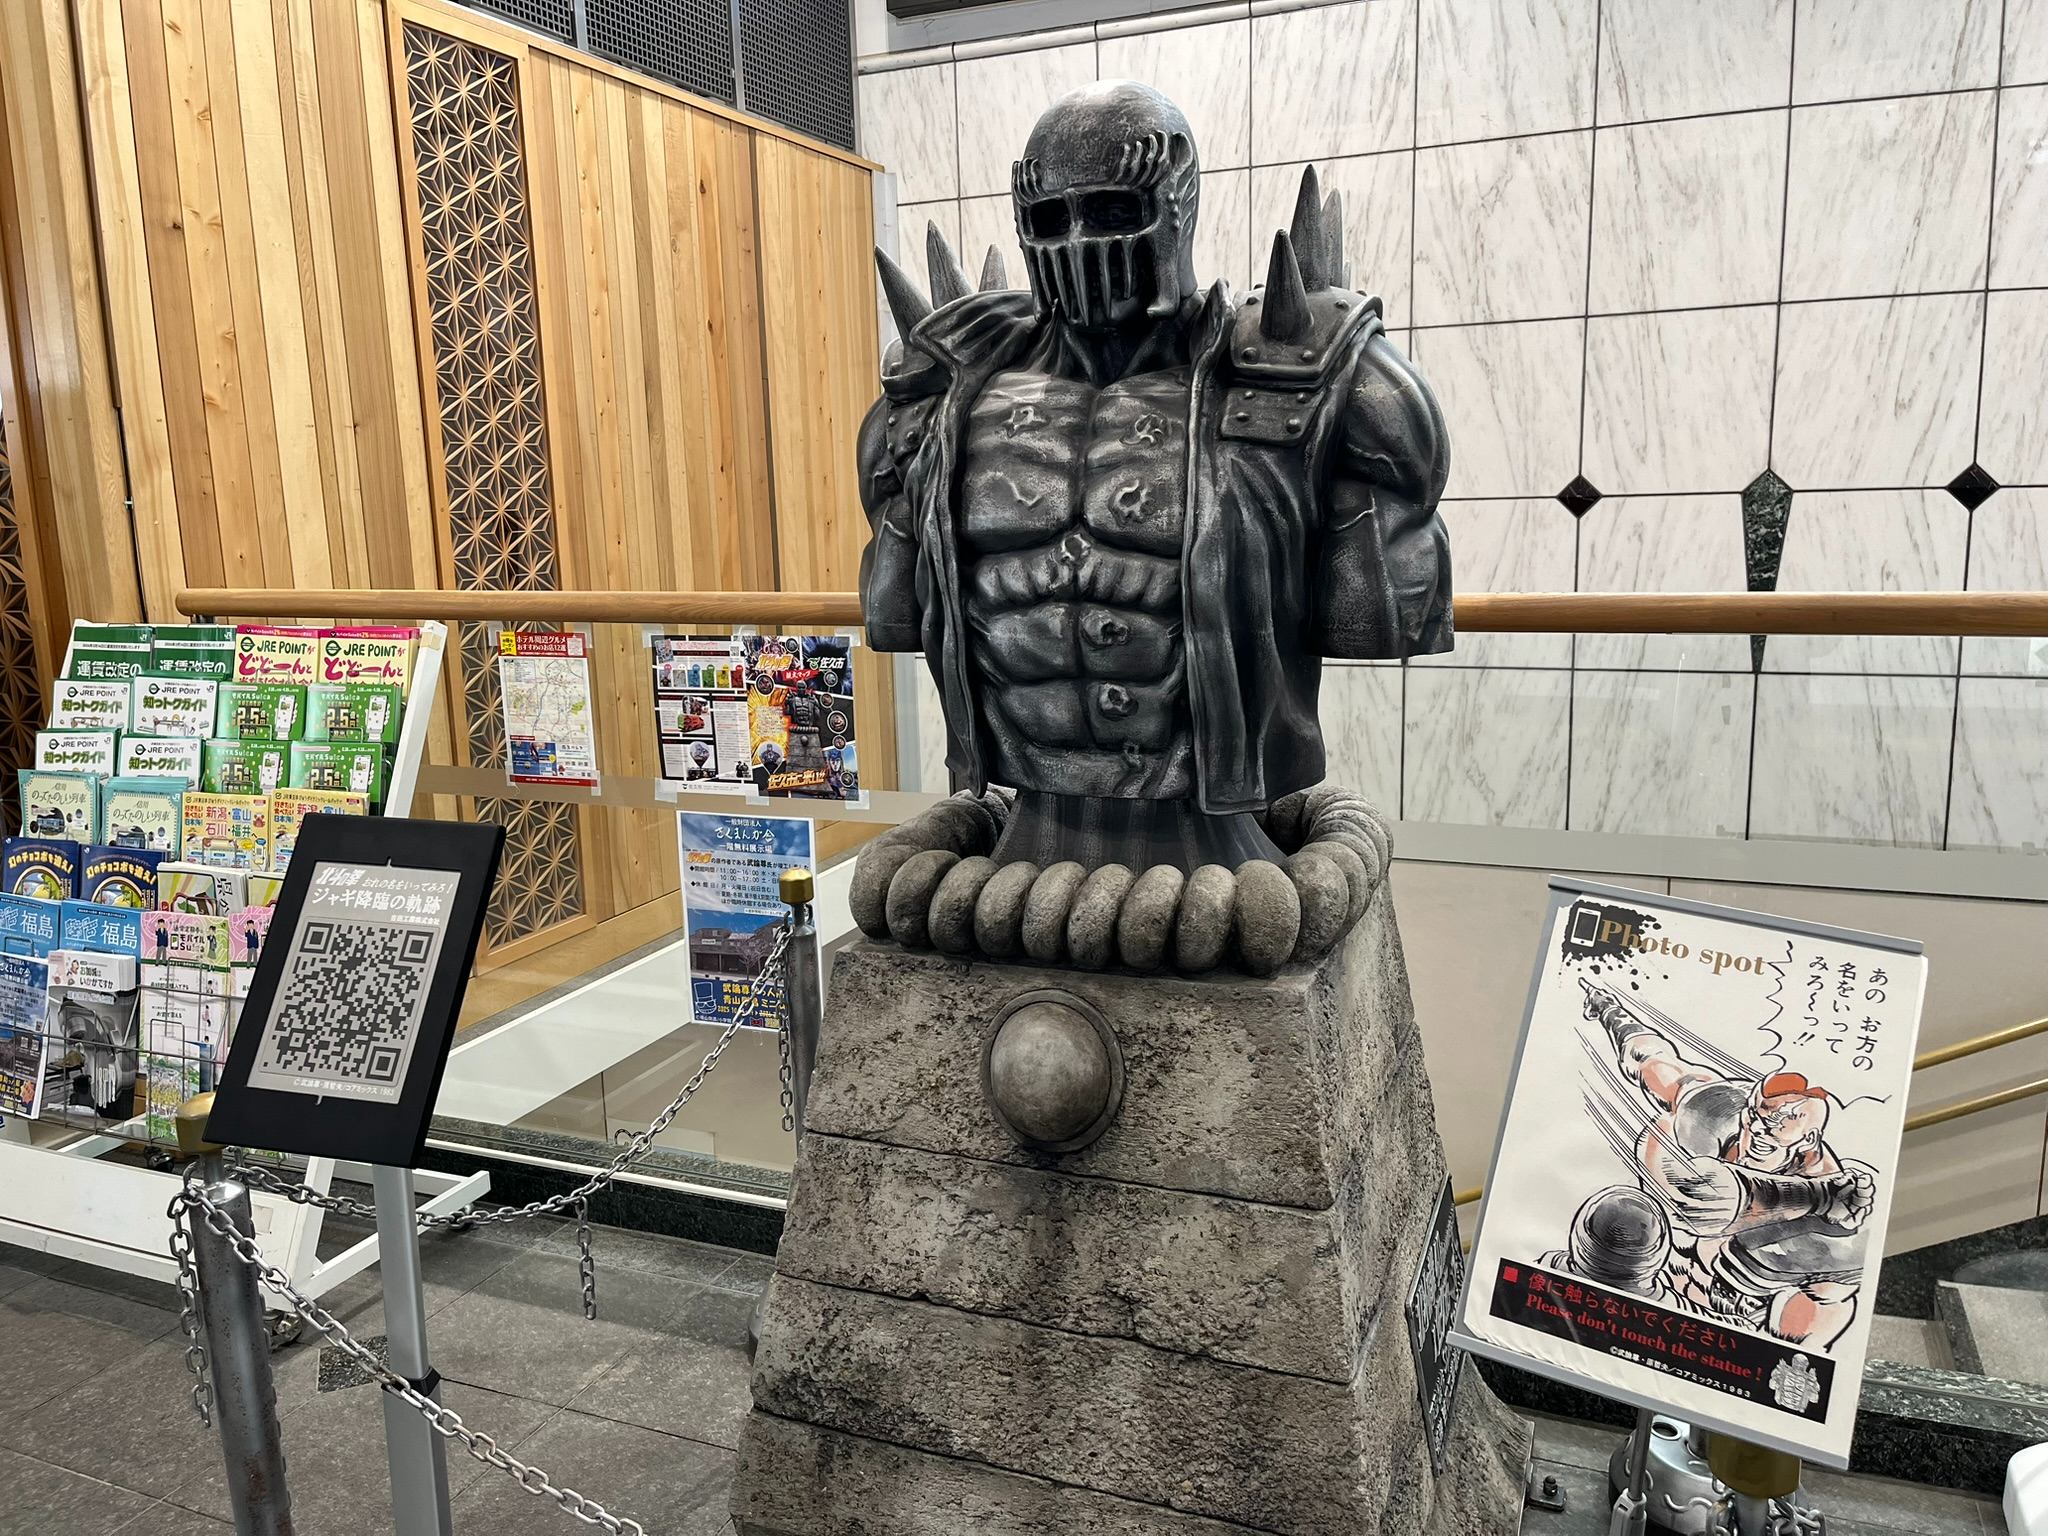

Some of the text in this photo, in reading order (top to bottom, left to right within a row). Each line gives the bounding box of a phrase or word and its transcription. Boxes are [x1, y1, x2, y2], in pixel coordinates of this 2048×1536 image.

[257, 640, 276, 652] JRE
[343, 644, 365, 656] JRE
[77, 660, 142, 677] 運賃改定の
[820, 657, 846, 668] 佐久市
[62, 698, 122, 713] 知っトクガイド
[143, 695, 207, 712] 知っトクガイド
[44, 751, 105, 764] 知っトクガイド
[128, 757, 192, 771] 知っトクガイド
[206, 807, 252, 820] 新潟・富山
[725, 819, 761, 827] 一般財団法人
[720, 843, 773, 853] 一階無料展示場
[316, 867, 366, 886] 北斗の拳
[312, 887, 442, 914] ジャギ降臨の軌跡
[20, 910, 53, 939] 福島
[100, 920, 137, 949] 福島
[180, 934, 205, 944] モバイル
[1599, 918, 1767, 976] Photo spot
[1826, 961, 1857, 1054] 名をいって
[1852, 968, 1889, 1071] あの お方の
[1528, 1272, 1738, 1351] 像に触らないでください
[1525, 1293, 1573, 1323] Please
[1576, 1309, 1618, 1336] don't
[1621, 1325, 1667, 1352] touch
[1671, 1342, 1697, 1361] the
[1700, 1353, 1752, 1378] statue
